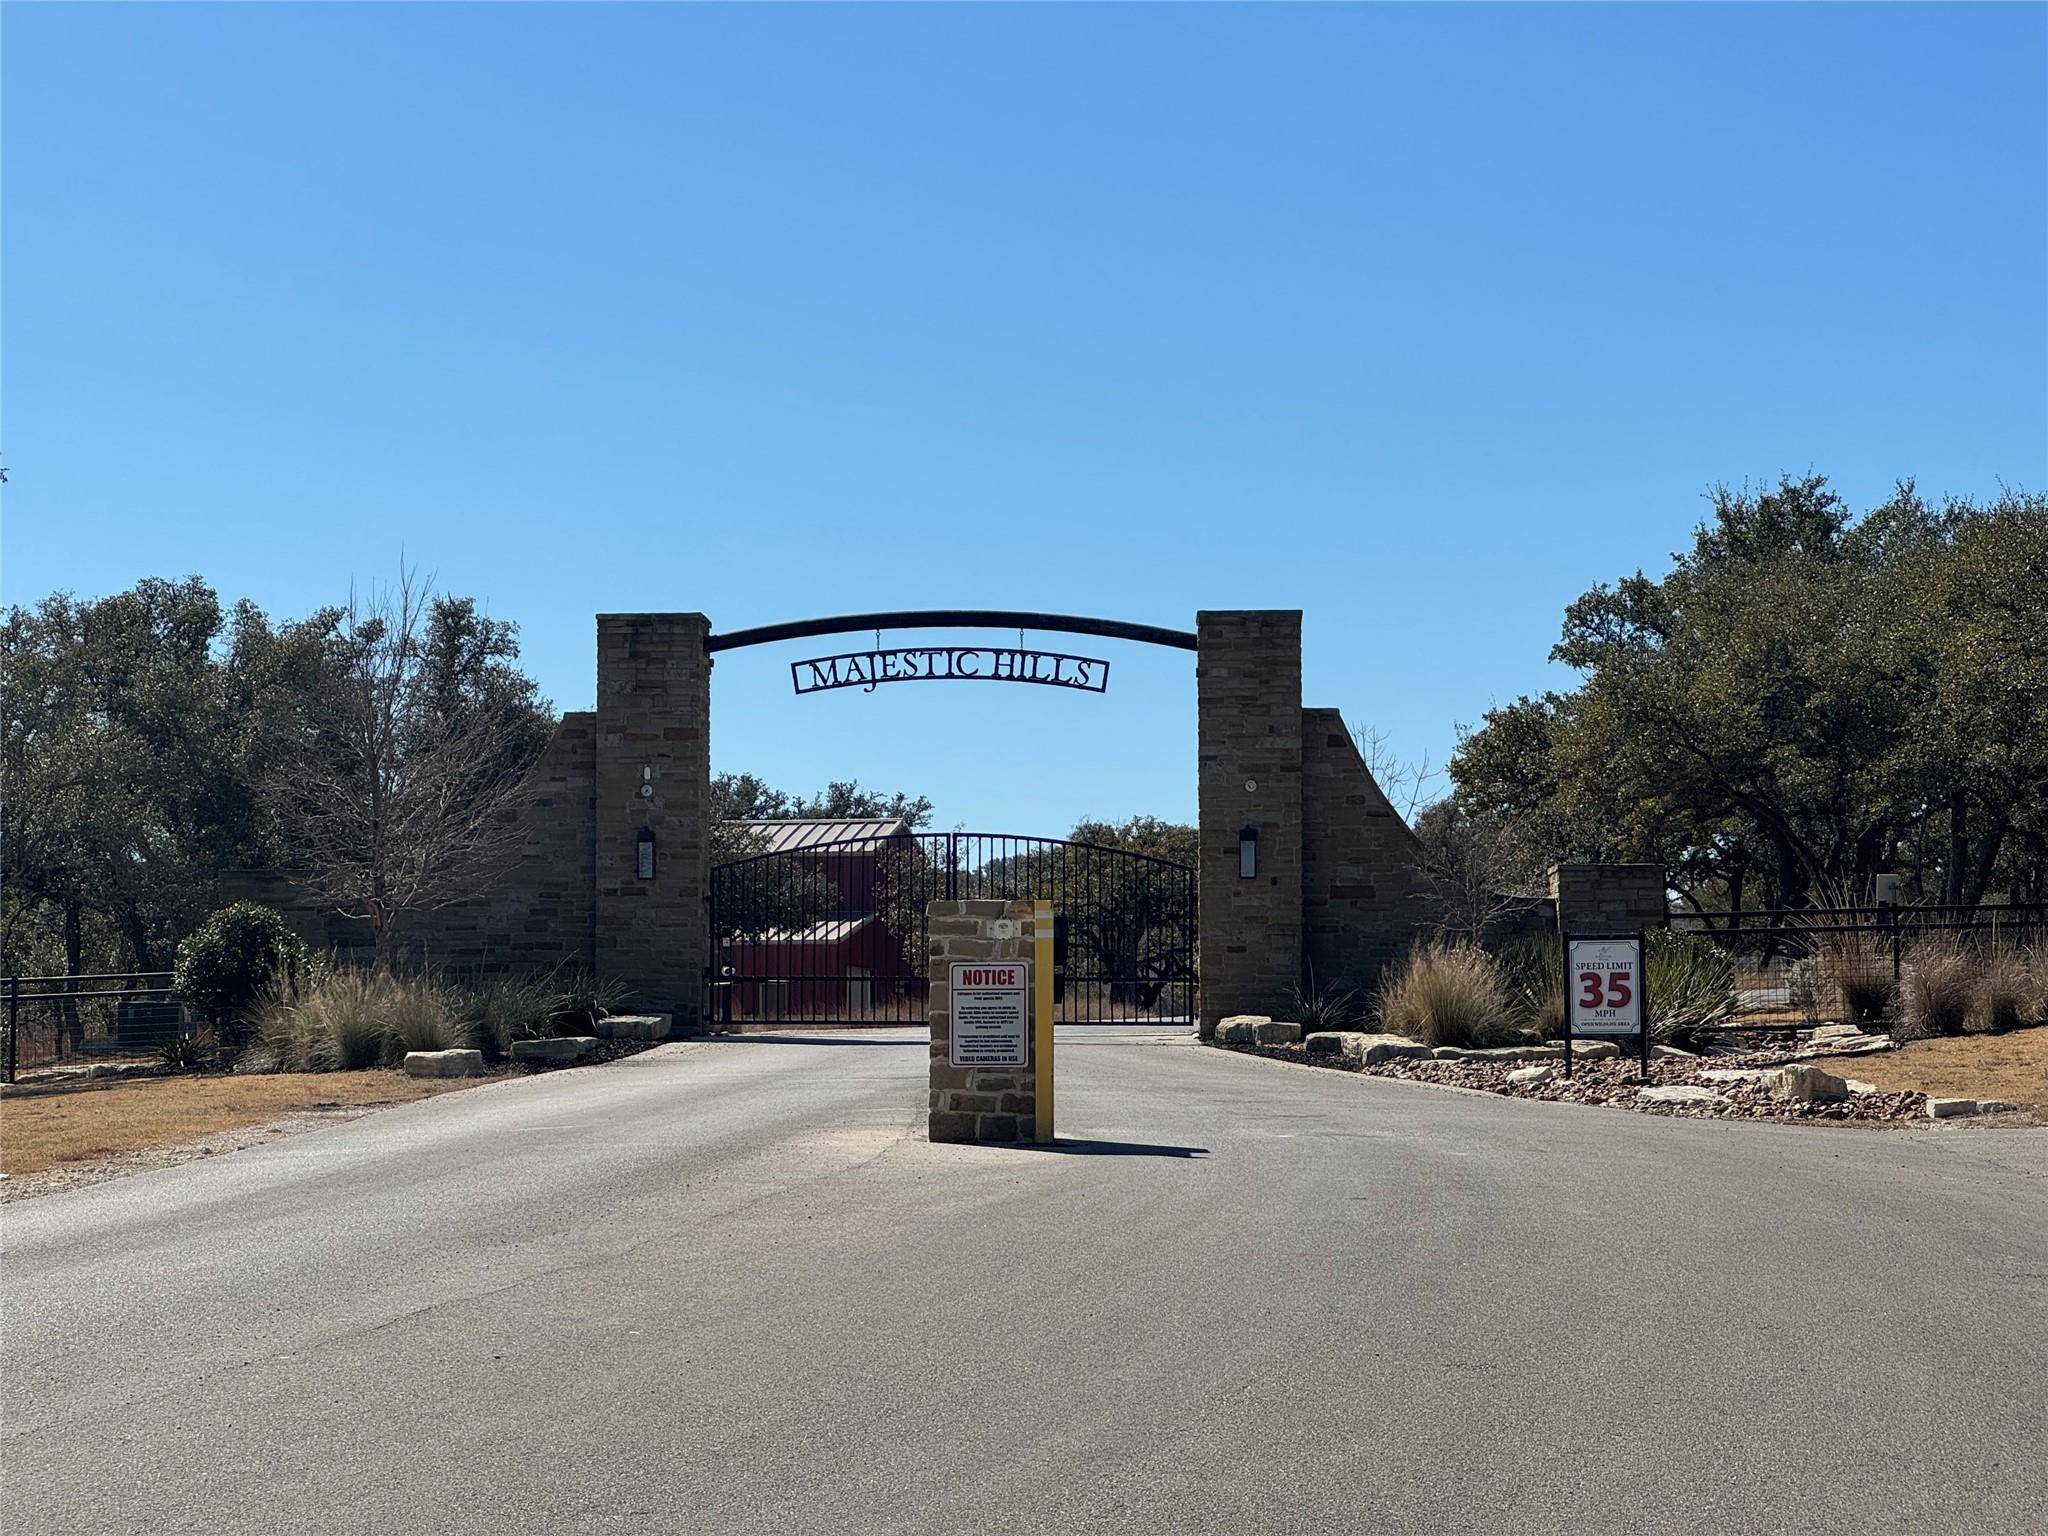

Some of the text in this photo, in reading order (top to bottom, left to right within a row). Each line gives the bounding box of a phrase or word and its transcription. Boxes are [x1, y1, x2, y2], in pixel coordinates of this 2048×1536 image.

[809, 650, 1091, 692] MAJESTIC HILLS
[1575, 961, 1633, 970] SPEED LIMIT
[962, 969, 1015, 986] NOTICE
[1579, 972, 1631, 1008] 35
[1594, 1009, 1616, 1017] MPH
